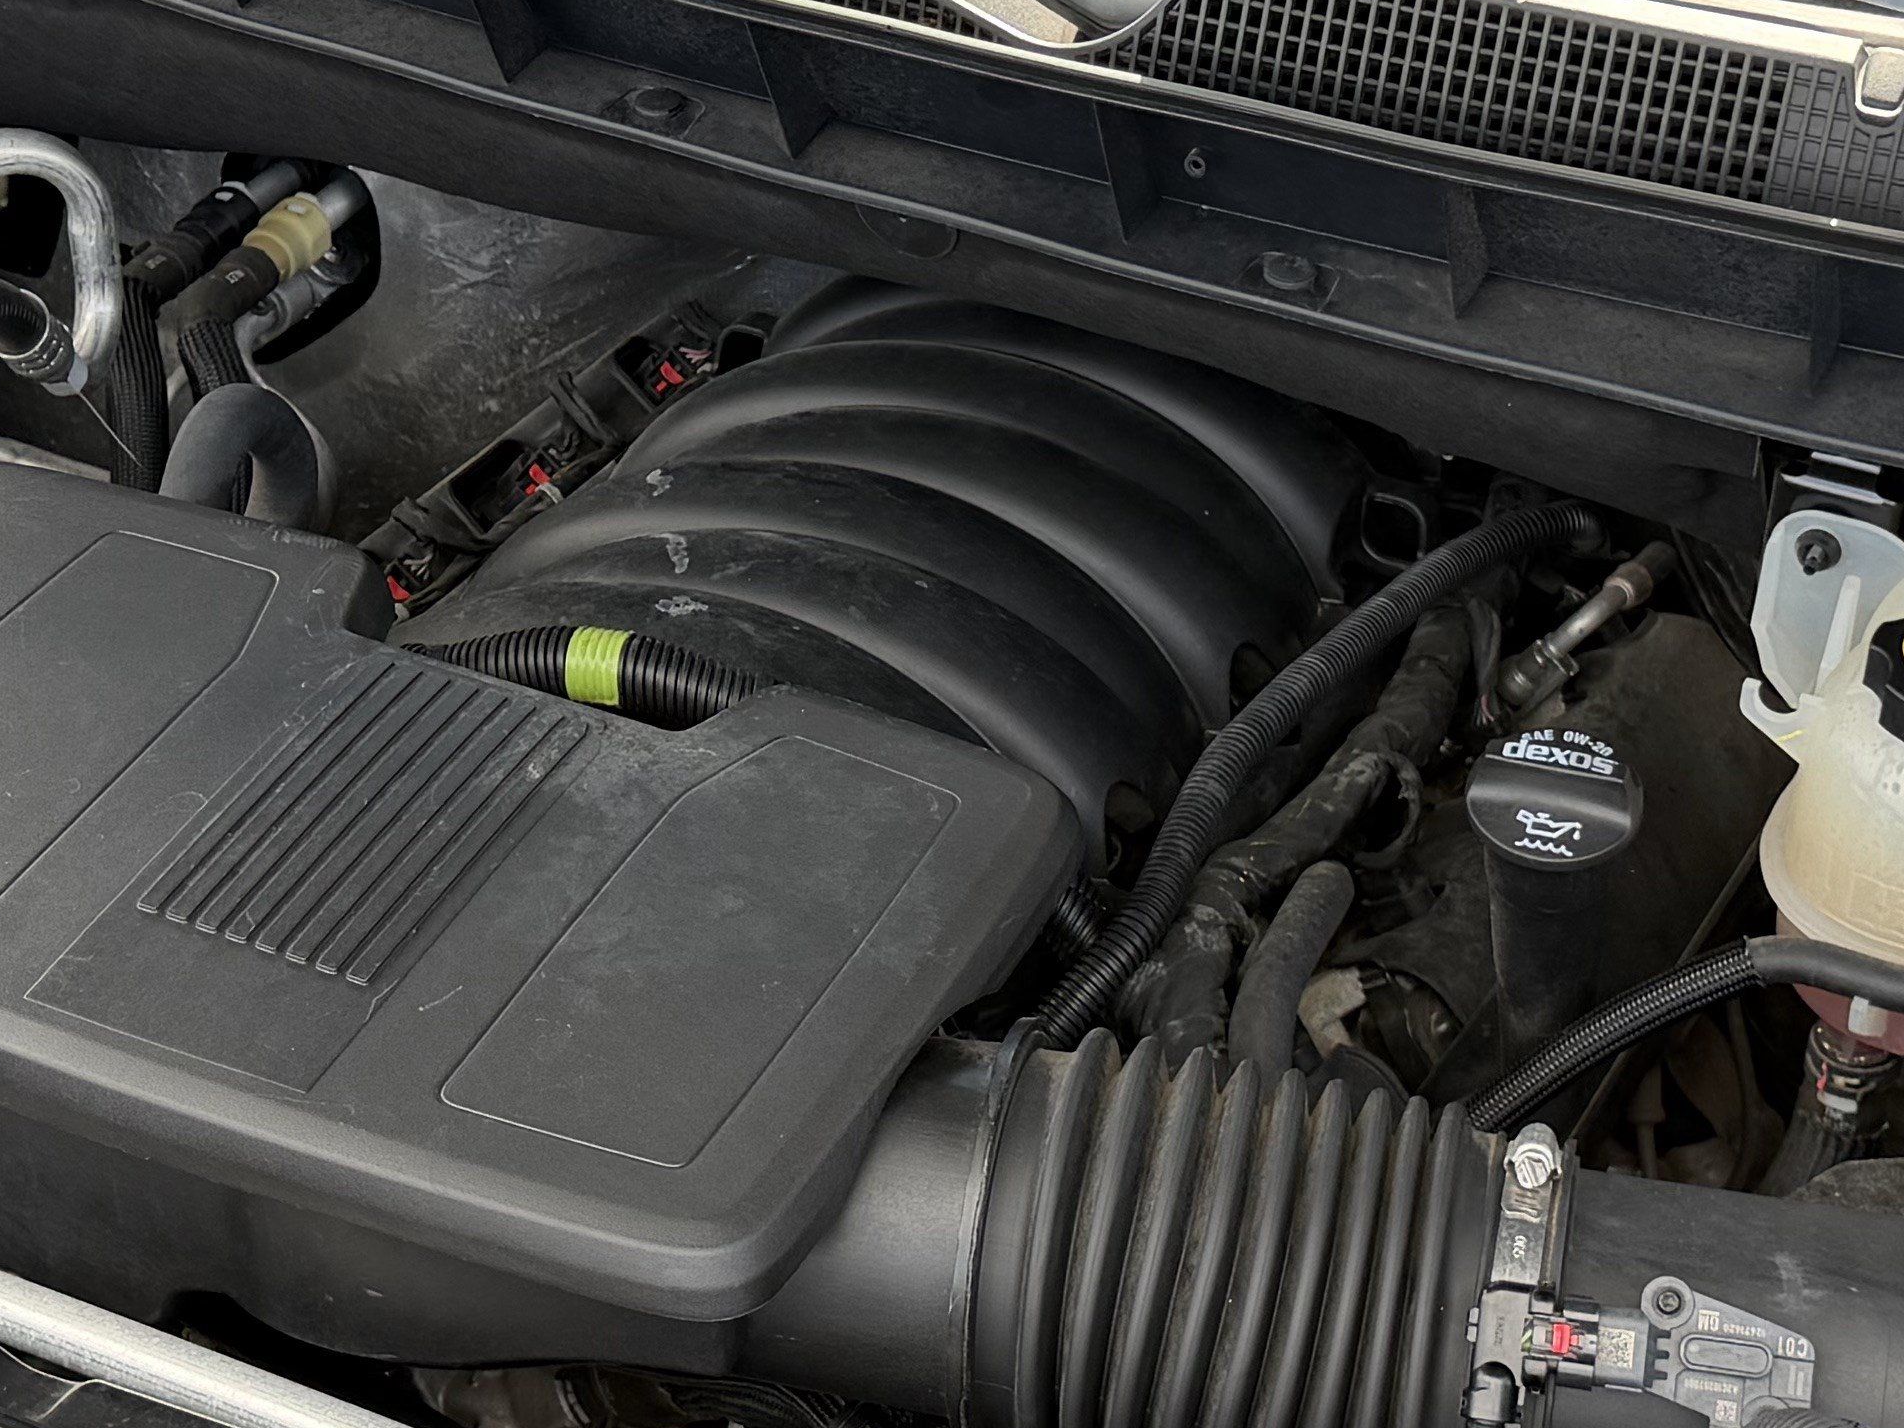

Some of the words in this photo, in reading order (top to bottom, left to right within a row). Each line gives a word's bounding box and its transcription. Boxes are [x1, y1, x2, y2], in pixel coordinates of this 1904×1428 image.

[1521, 729, 1555, 742] SAE
[1563, 729, 1614, 757] 0W-20
[1502, 740, 1620, 775] dexos
[1697, 1314, 1720, 1332] GM
[1777, 1335, 1809, 1358] C01
